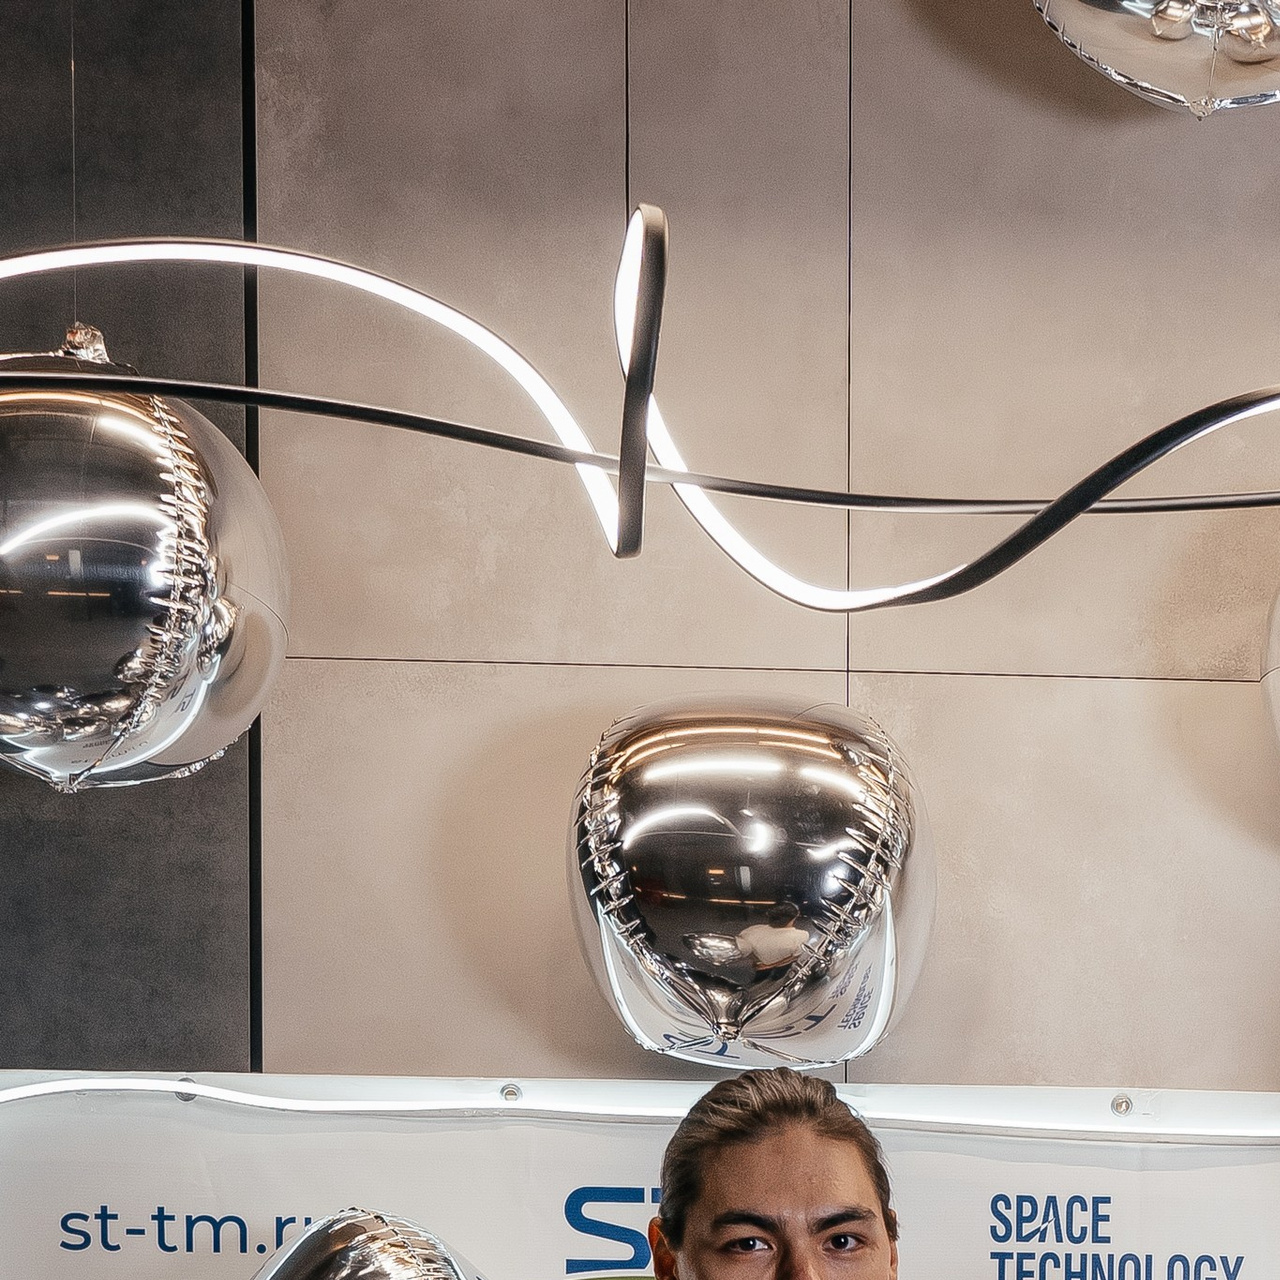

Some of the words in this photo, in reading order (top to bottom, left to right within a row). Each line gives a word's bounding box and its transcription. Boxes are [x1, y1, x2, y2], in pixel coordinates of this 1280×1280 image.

[59, 1205, 313, 1253] st-tm.r
[564, 1186, 662, 1275] S
[989, 1193, 1112, 1244] SPACE
